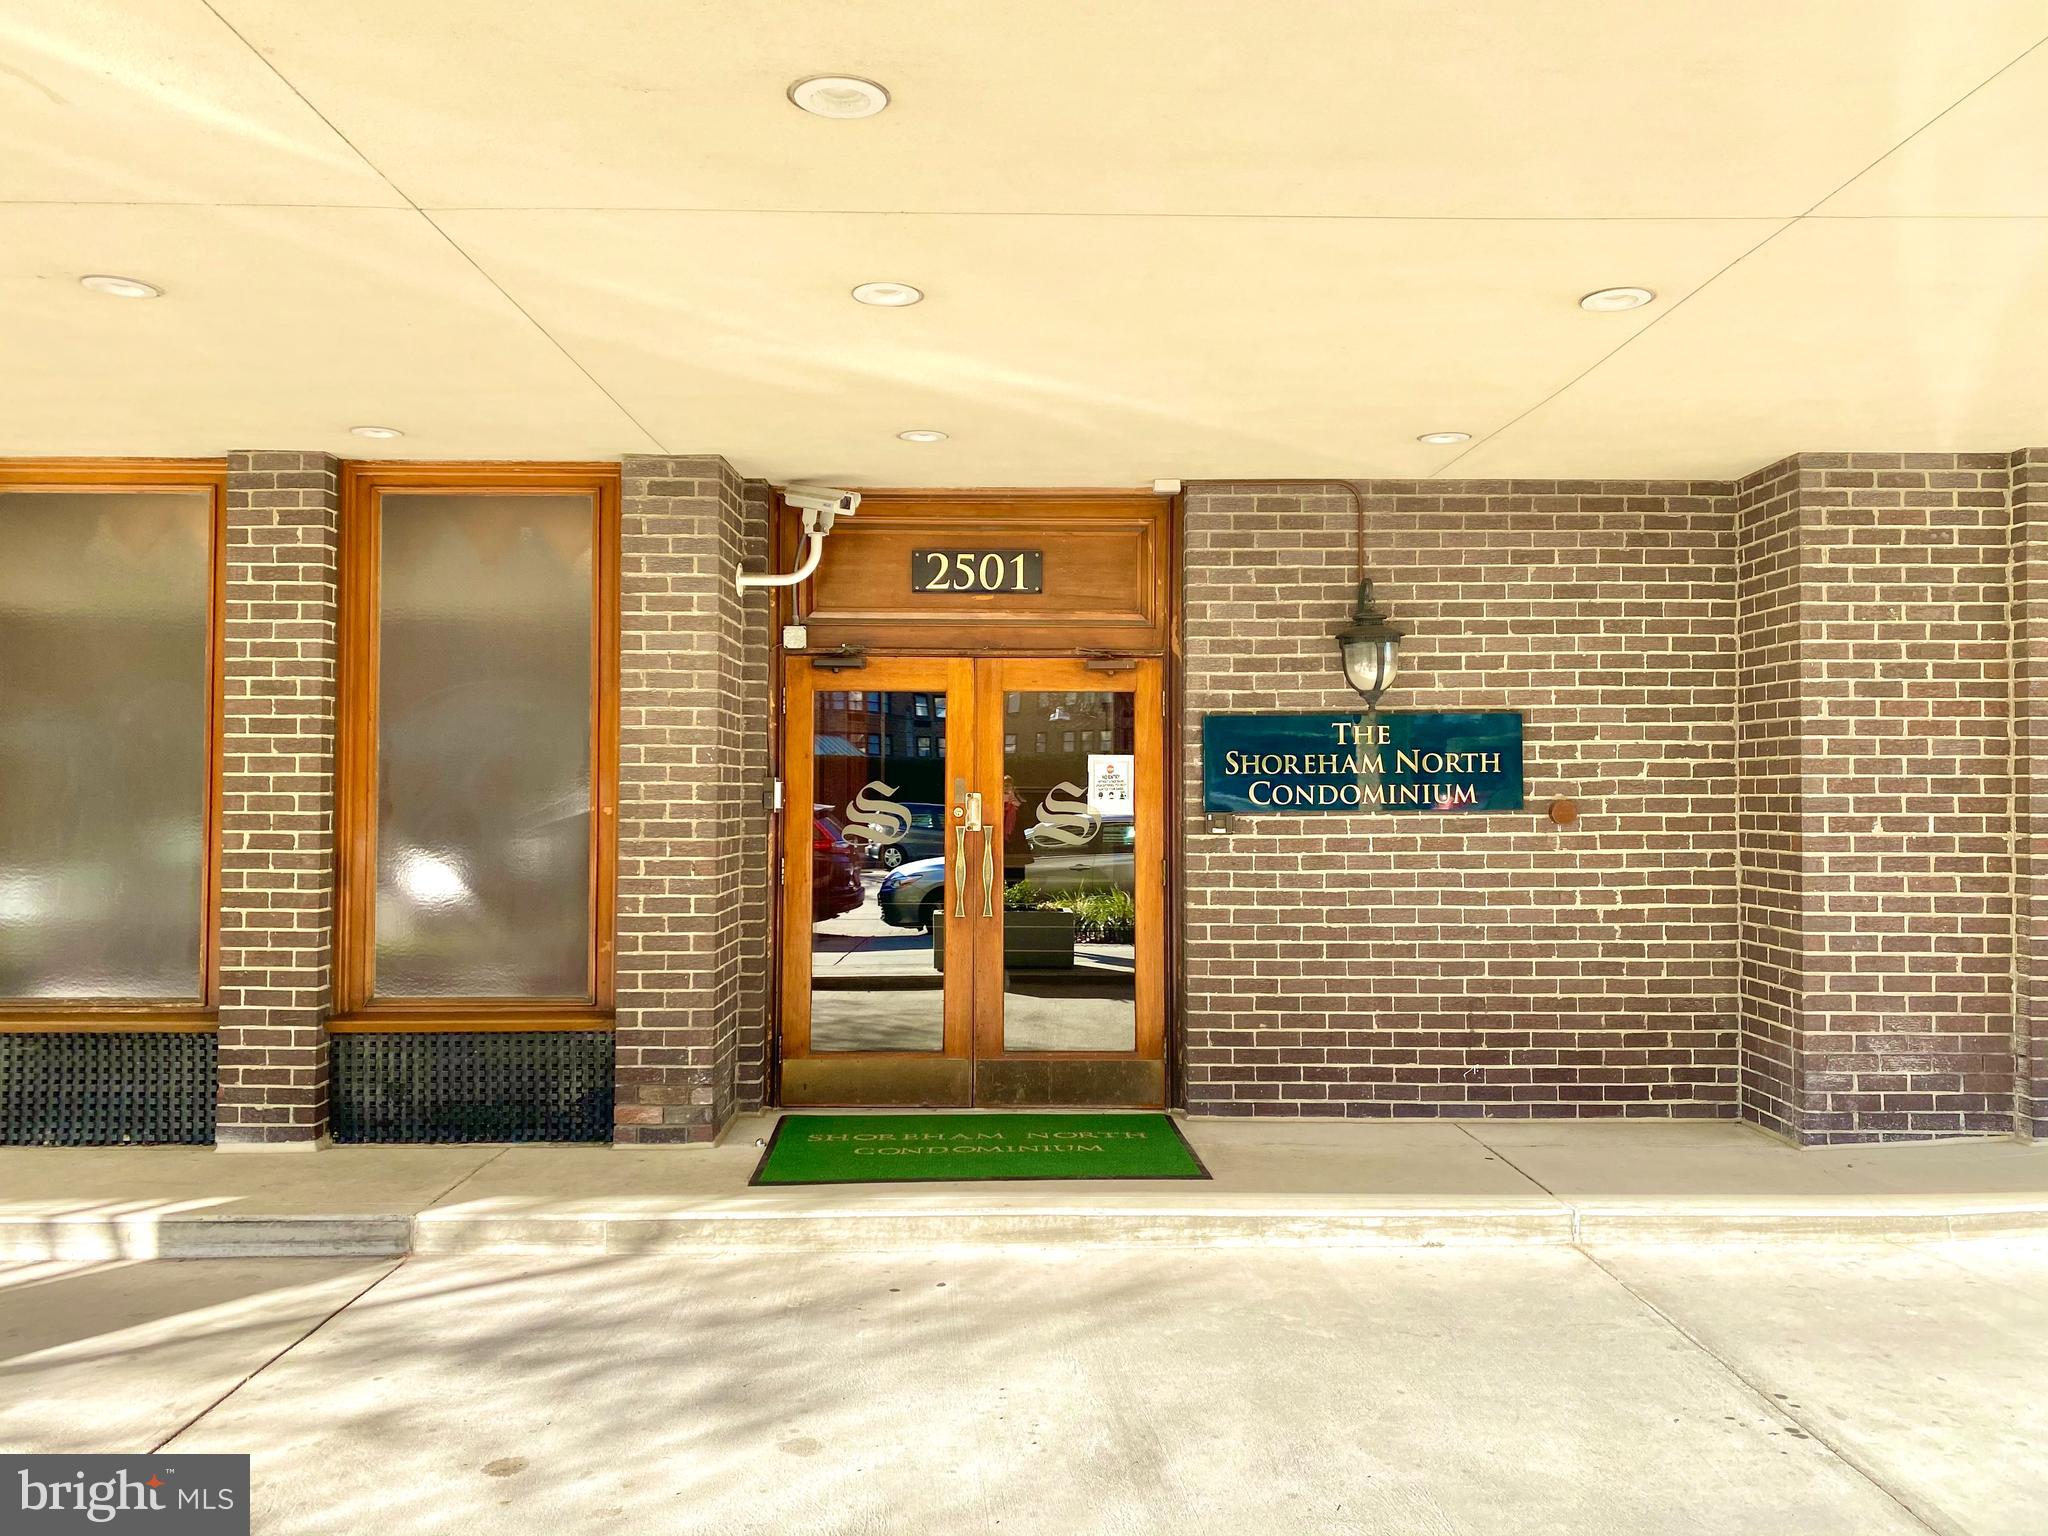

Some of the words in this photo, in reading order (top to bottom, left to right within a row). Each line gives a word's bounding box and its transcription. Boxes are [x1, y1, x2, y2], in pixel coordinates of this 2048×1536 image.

[926, 553, 1029, 591] 2501
[807, 1131, 1005, 1142] SHOREHAM
[1027, 1130, 1149, 1140] NORTH
[854, 1144, 1104, 1155] CONDOMINIUM
